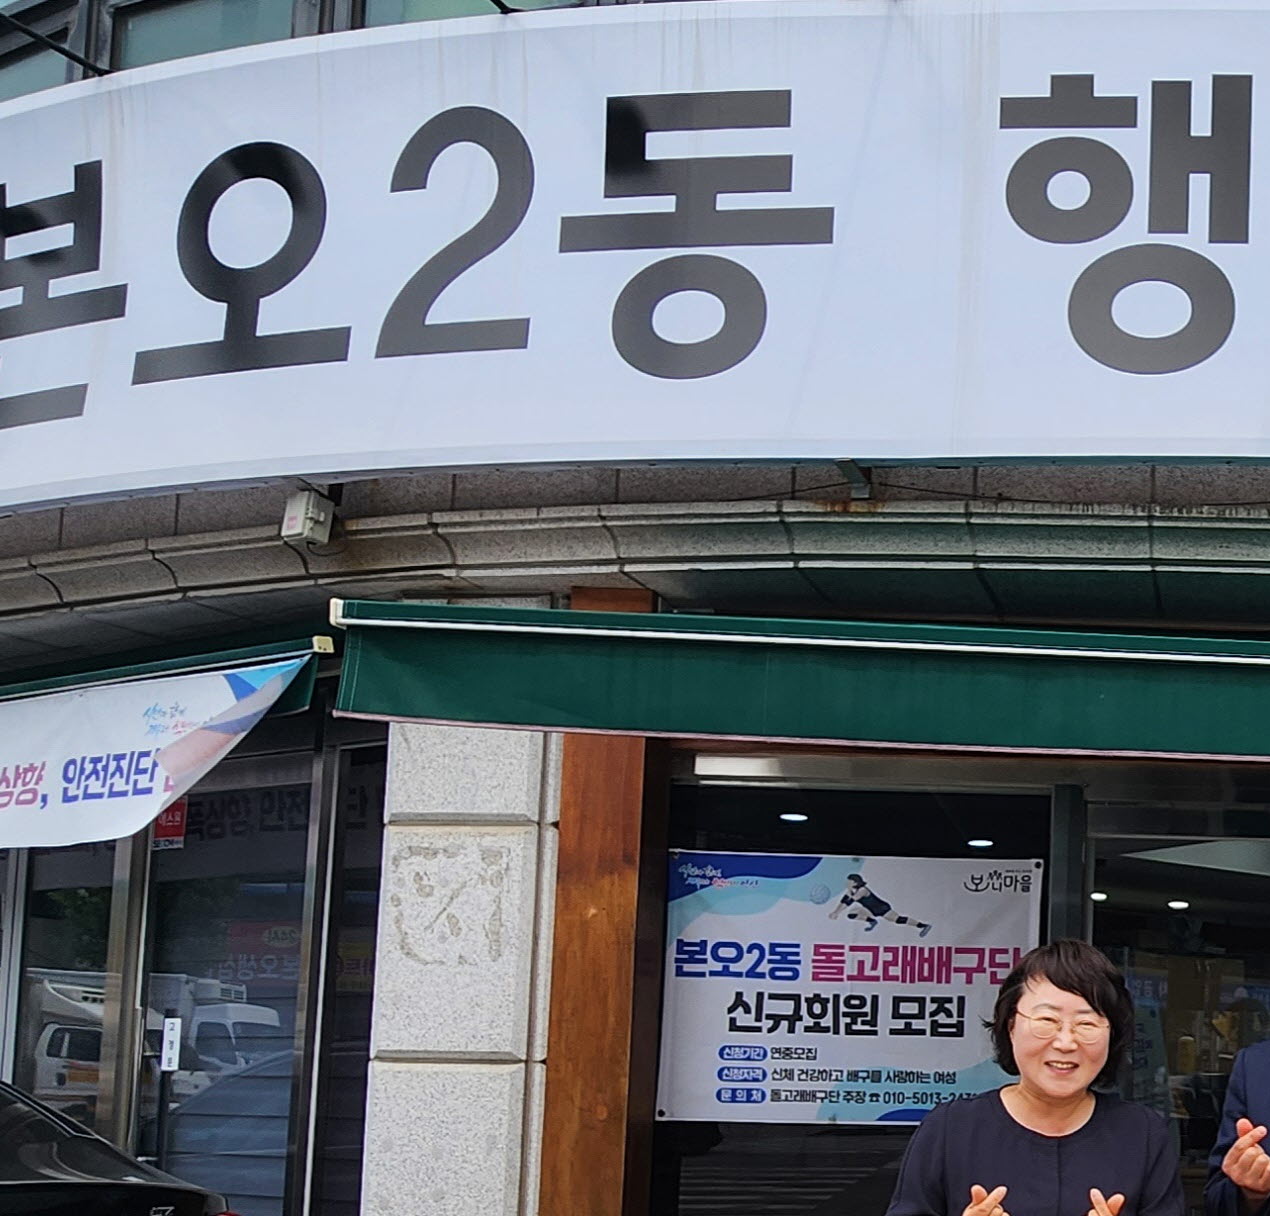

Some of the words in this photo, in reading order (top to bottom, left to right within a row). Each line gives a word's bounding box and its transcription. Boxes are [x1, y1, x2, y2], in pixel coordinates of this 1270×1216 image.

[0, 89, 834, 430] 본오2동
[62, 748, 160, 804] 안전진단
[674, 938, 801, 981] 본오2동
[811, 943, 1024, 986] 돌고래배구단
[727, 991, 879, 1037] 신규회원
[889, 994, 966, 1038] 모집
[722, 1046, 765, 1061] 신청기간
[770, 1047, 818, 1061] 연중모집
[771, 1068, 794, 1082] 신체
[797, 1069, 844, 1083] 건강하고
[846, 1069, 882, 1084] 배구를
[885, 1070, 931, 1085] 사랑하는
[933, 1071, 957, 1085] 여성
[770, 1088, 840, 1104] 돌고래배구단
